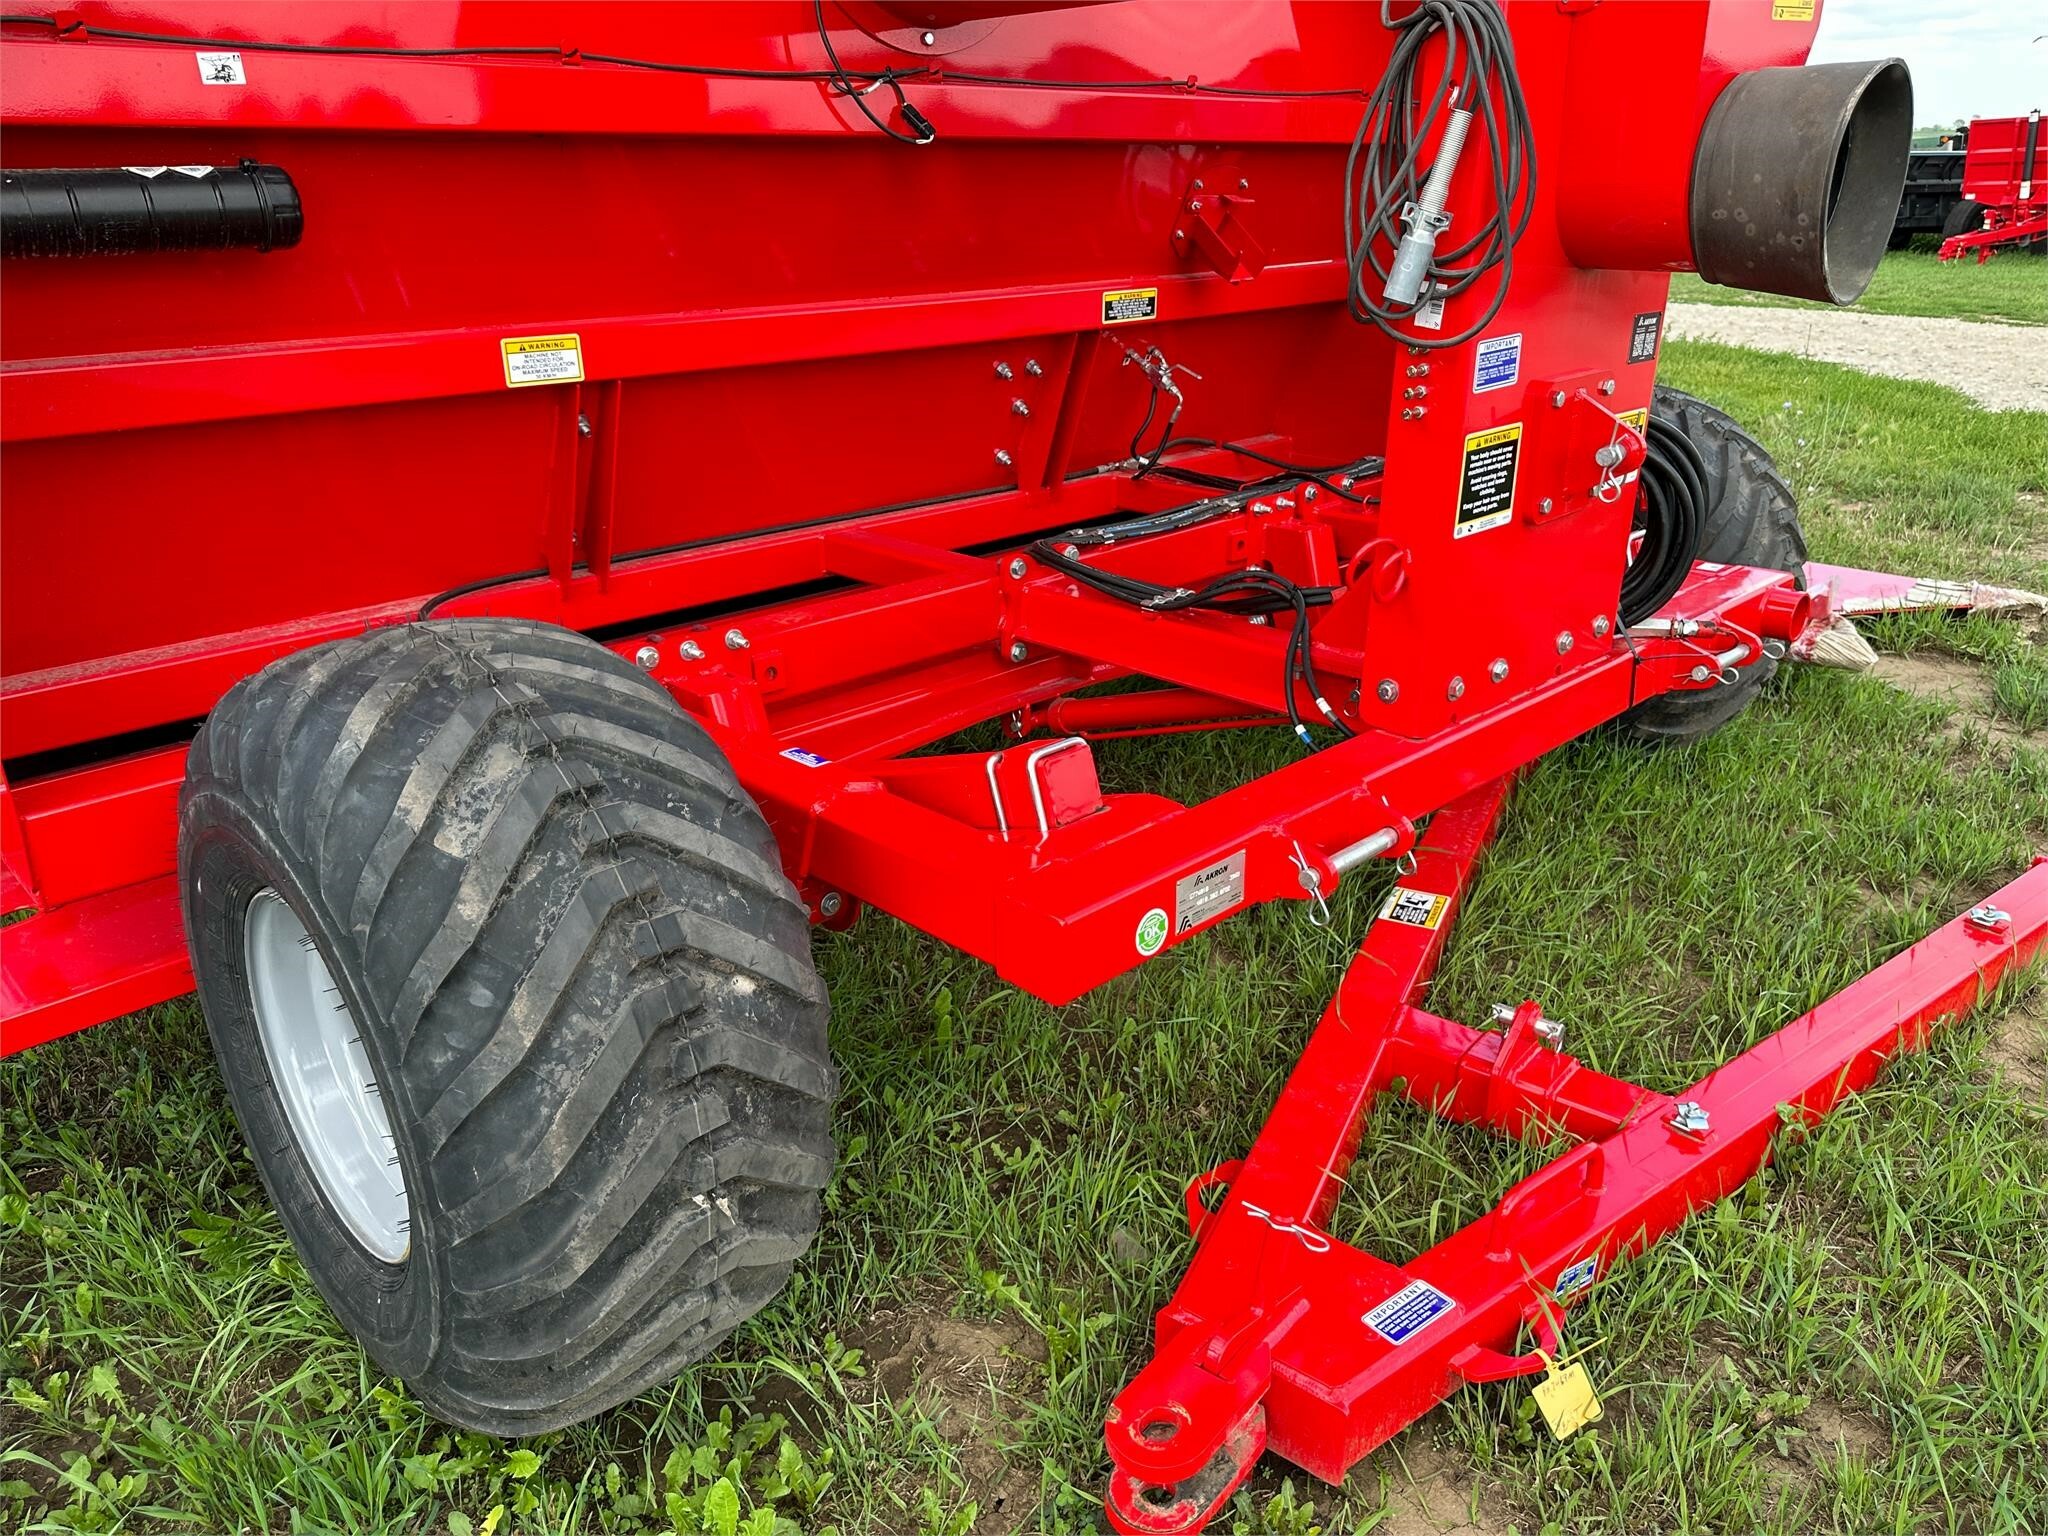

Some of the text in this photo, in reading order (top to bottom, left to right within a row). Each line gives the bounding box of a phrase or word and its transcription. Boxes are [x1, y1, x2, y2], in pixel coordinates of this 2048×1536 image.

[1484, 339, 1516, 351] IMPORTANT
[1484, 433, 1511, 444] WARNING
[1463, 503, 1473, 511] Keep
[1205, 865, 1229, 882] AKRON
[1144, 921, 1160, 941] OK
[1369, 1285, 1423, 1322] IMPORTANT
[1377, 1319, 1393, 1329] BEFORE
